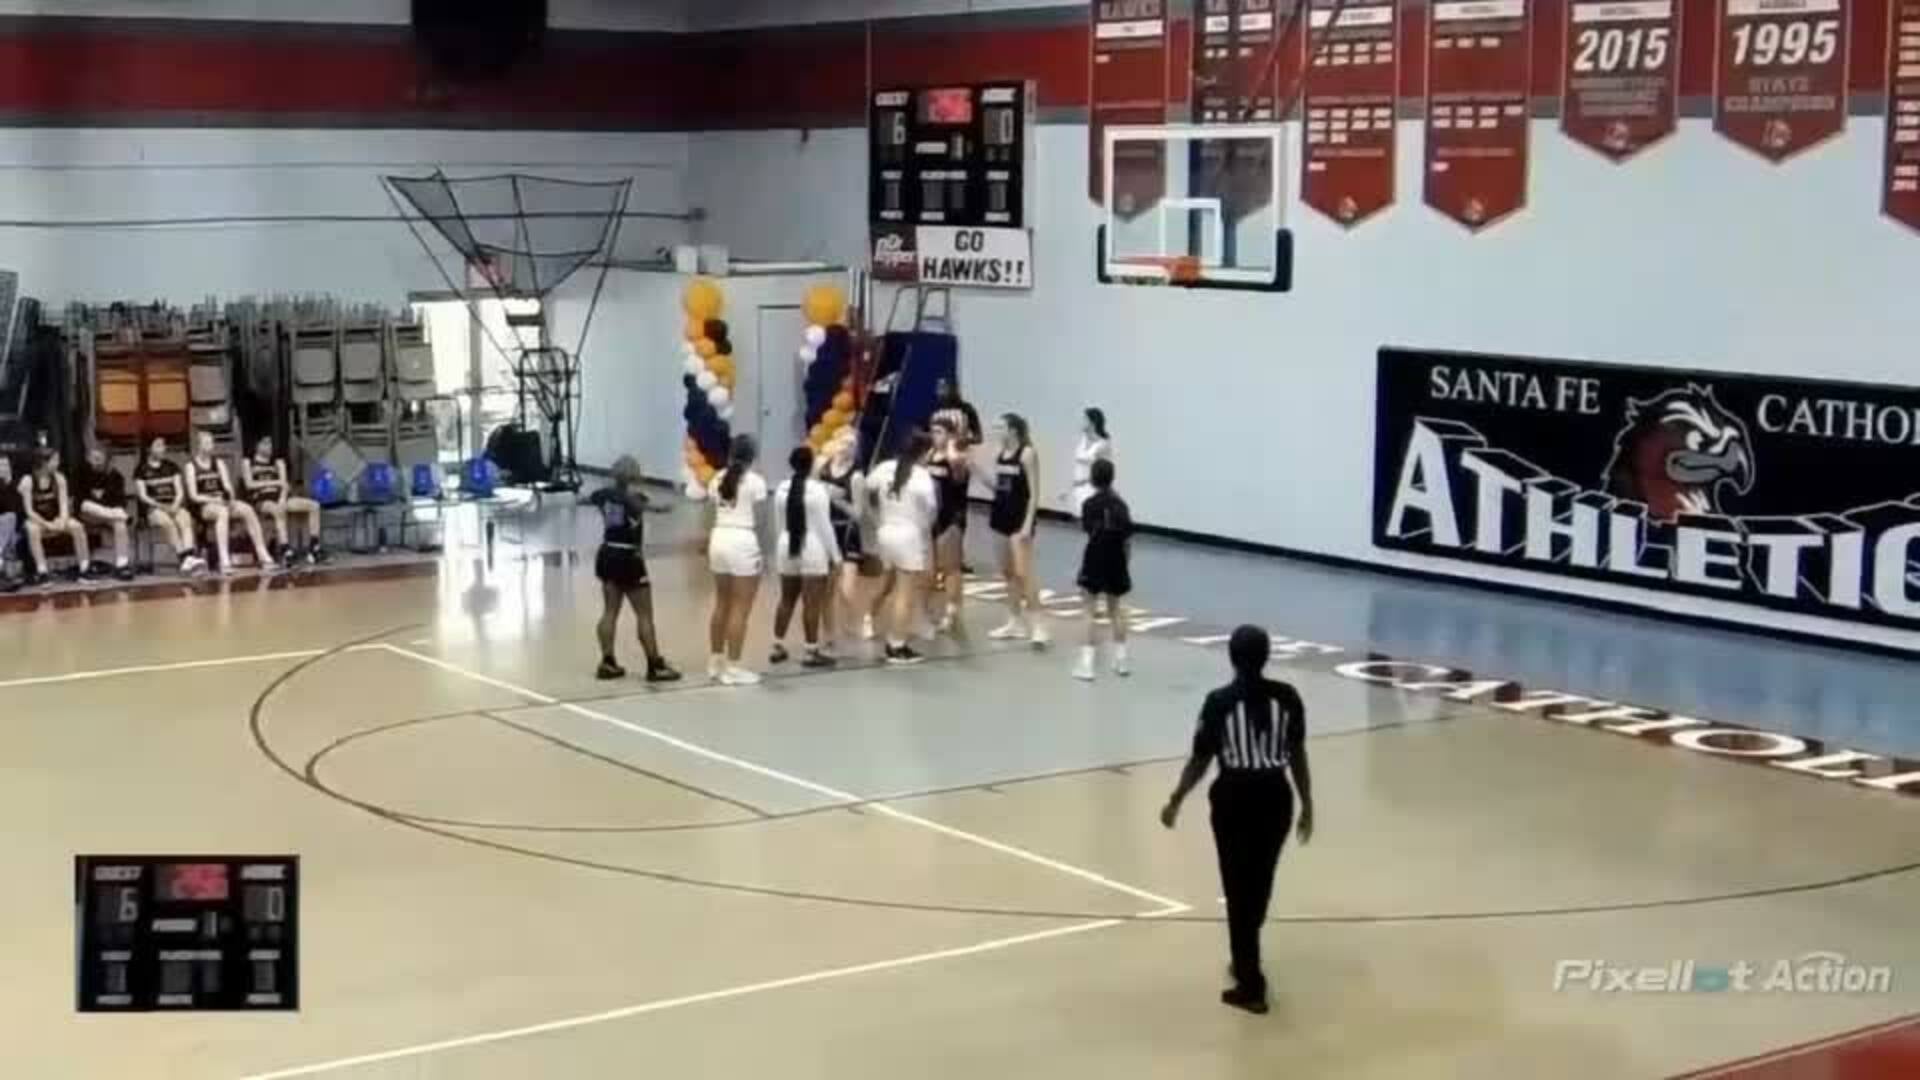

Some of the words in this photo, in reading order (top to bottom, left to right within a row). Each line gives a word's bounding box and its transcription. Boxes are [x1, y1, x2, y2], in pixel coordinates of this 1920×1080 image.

[1573, 28, 1670, 71] 2015
[1732, 21, 1840, 65] 1995
[954, 229, 985, 252] GO
[923, 256, 1025, 284] HAWKS!!
[1430, 364, 1547, 410] SANTA
[1555, 375, 1601, 414] FE
